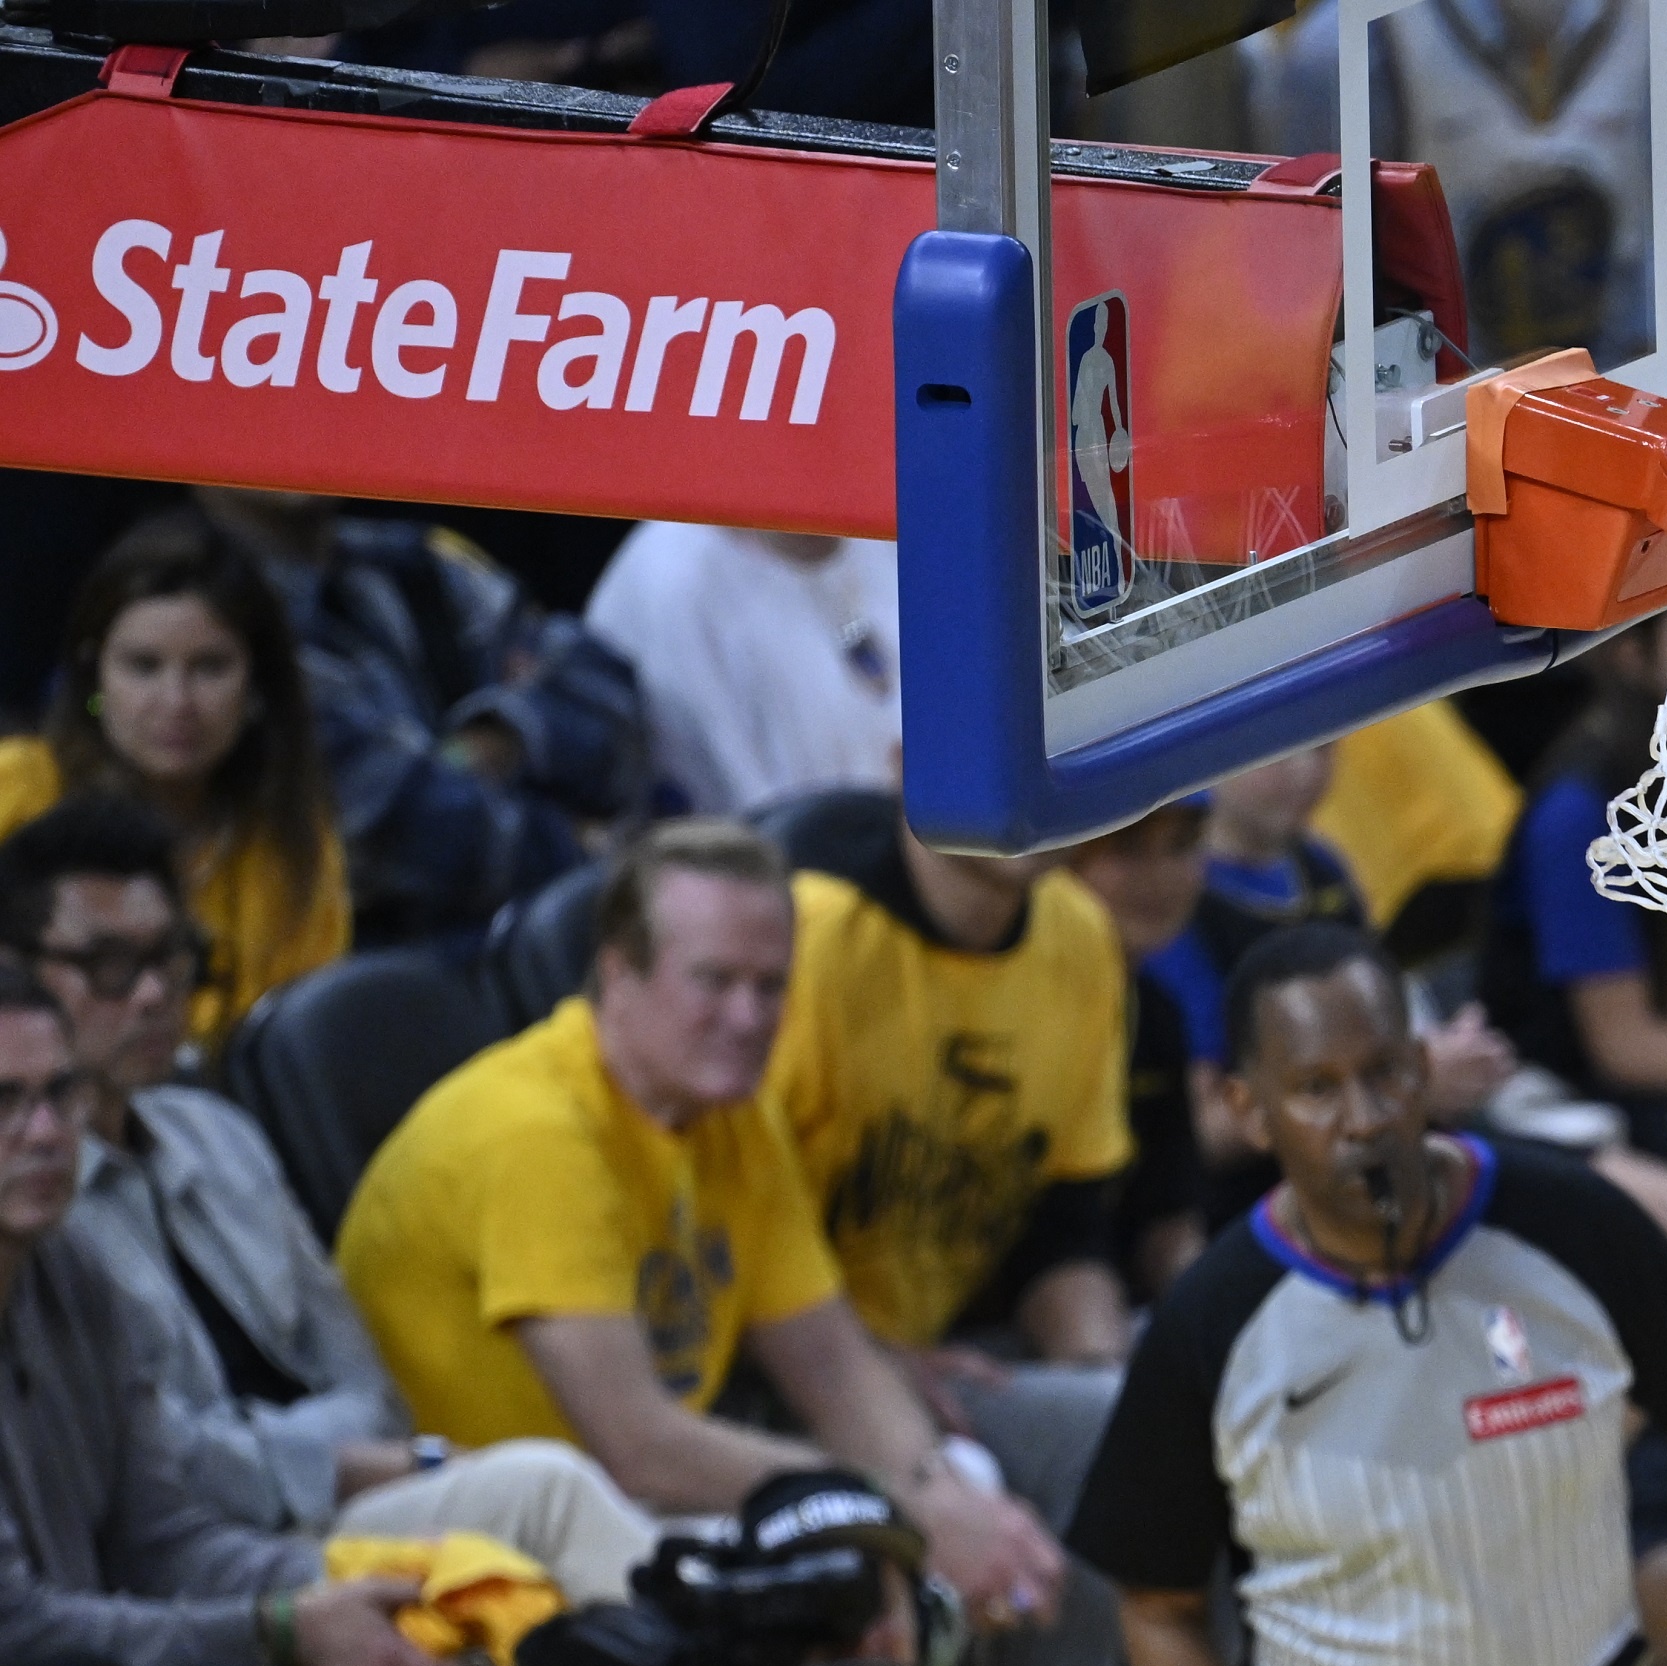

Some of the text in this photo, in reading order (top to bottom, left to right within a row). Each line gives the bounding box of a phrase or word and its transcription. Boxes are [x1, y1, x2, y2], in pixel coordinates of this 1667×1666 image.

[76, 218, 838, 426] State Farm
[1081, 540, 1111, 597] NBA
